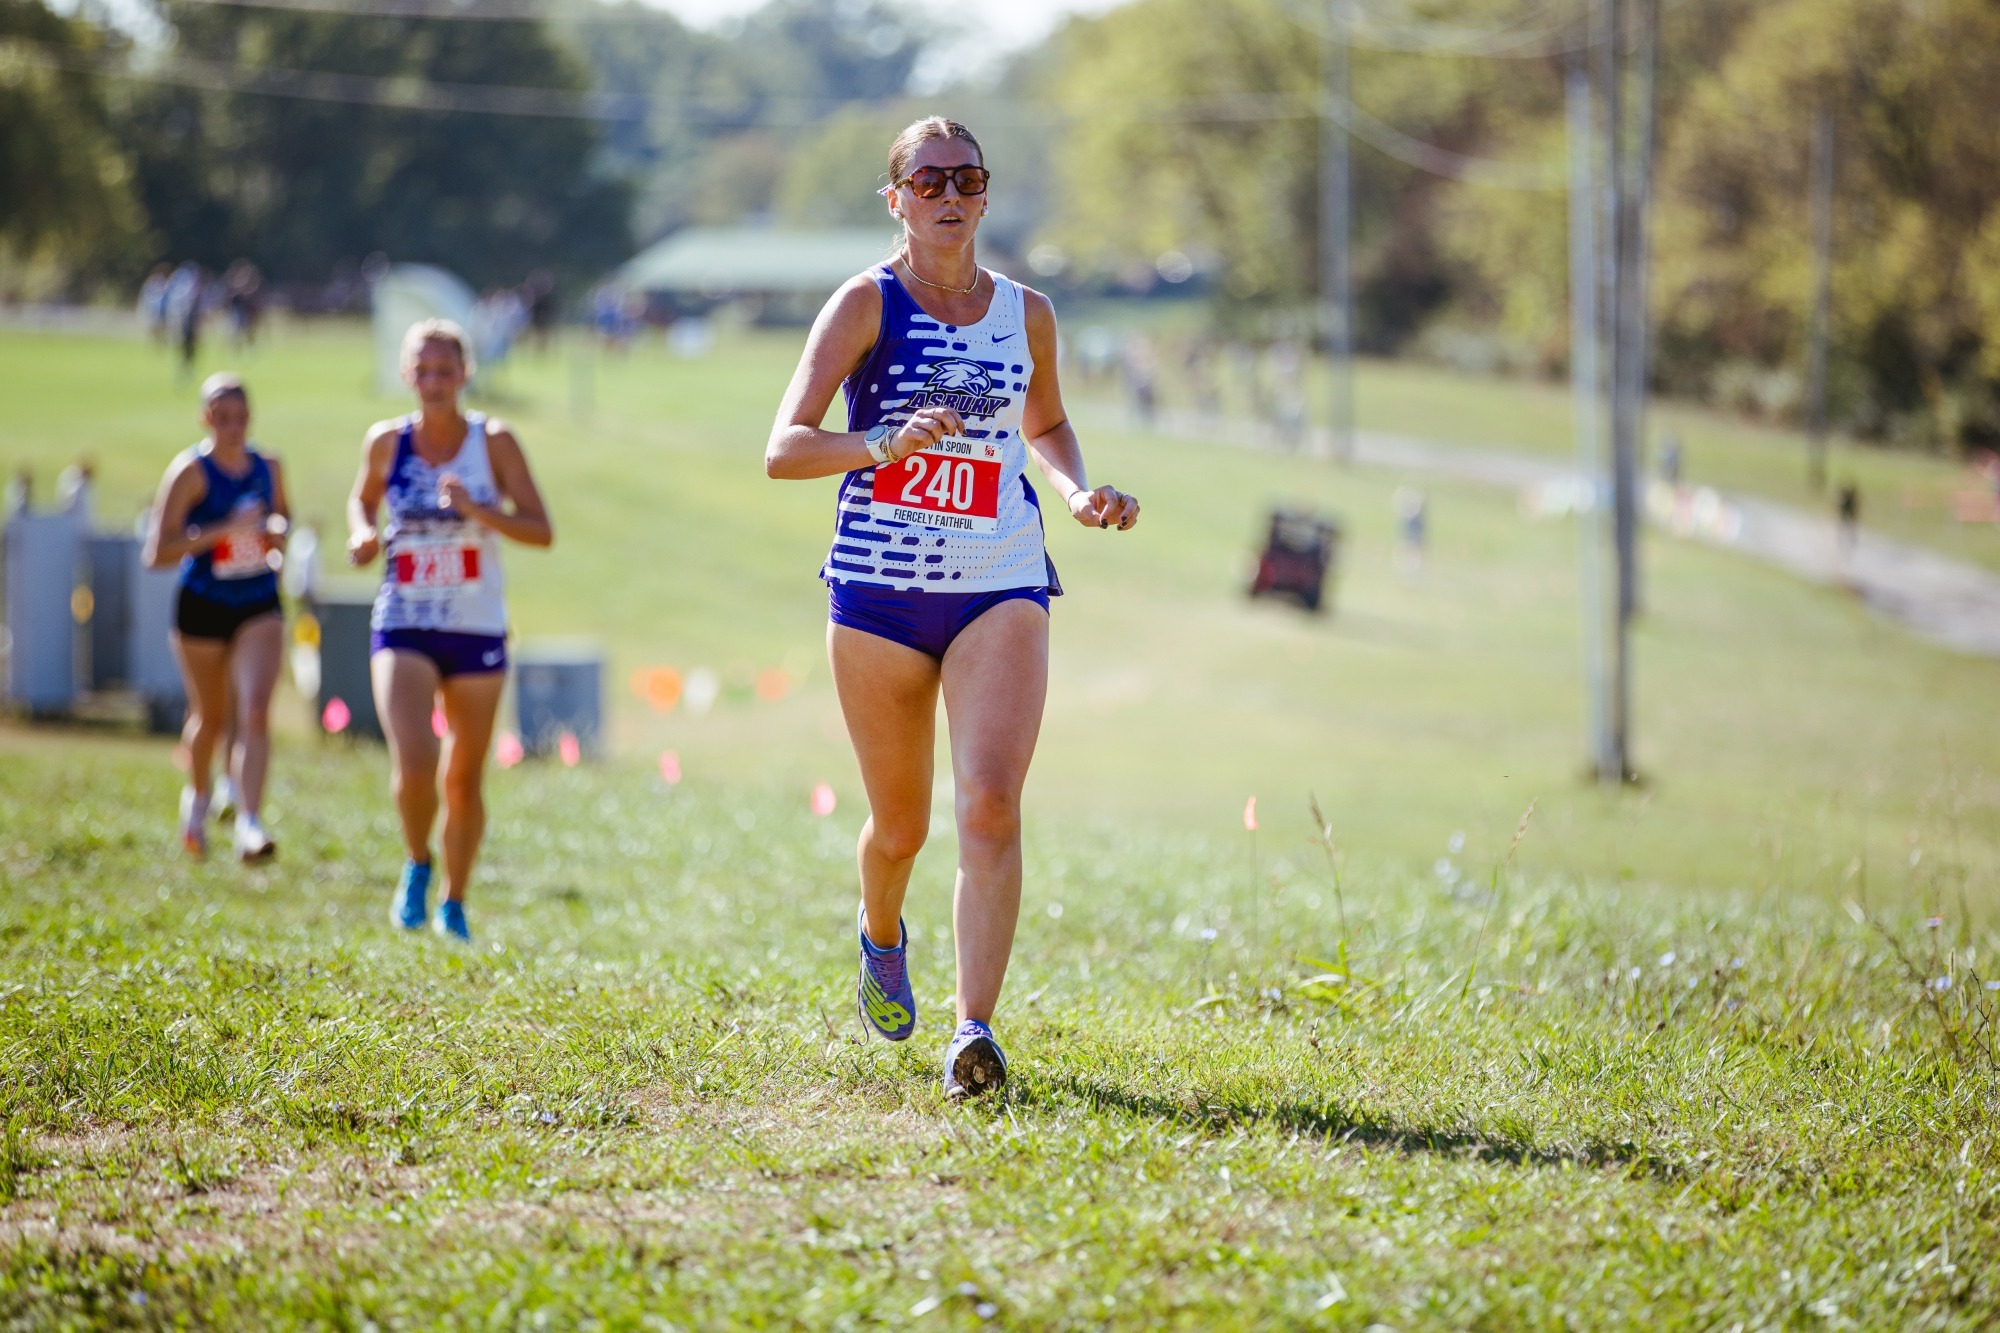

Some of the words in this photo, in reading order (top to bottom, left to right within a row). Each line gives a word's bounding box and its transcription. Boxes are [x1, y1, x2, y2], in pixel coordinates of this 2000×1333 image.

[907, 391, 1006, 416] ASBURY
[945, 440, 972, 455] SPOON
[901, 455, 974, 511] 240
[893, 508, 934, 525] FIERCELY
[934, 515, 974, 531] FAITHFUL
